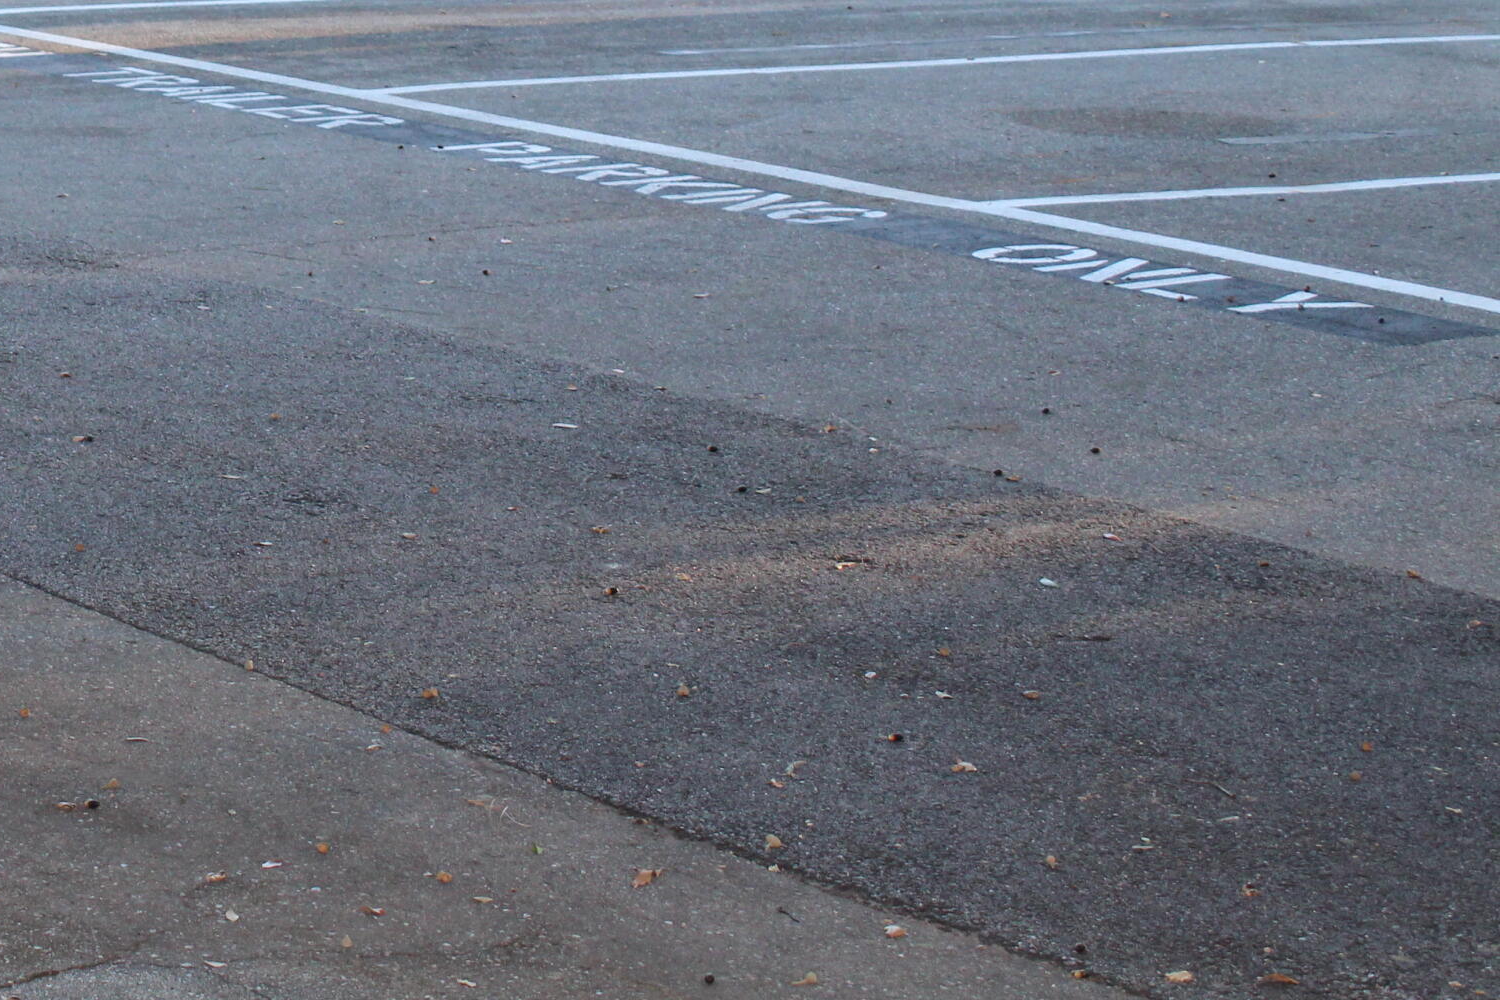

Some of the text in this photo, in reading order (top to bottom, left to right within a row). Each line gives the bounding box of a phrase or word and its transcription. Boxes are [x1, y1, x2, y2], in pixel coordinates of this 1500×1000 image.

[63, 66, 406, 129] TRAILER
[430, 141, 887, 225] PARKING
[971, 243, 1374, 314] ONLY
